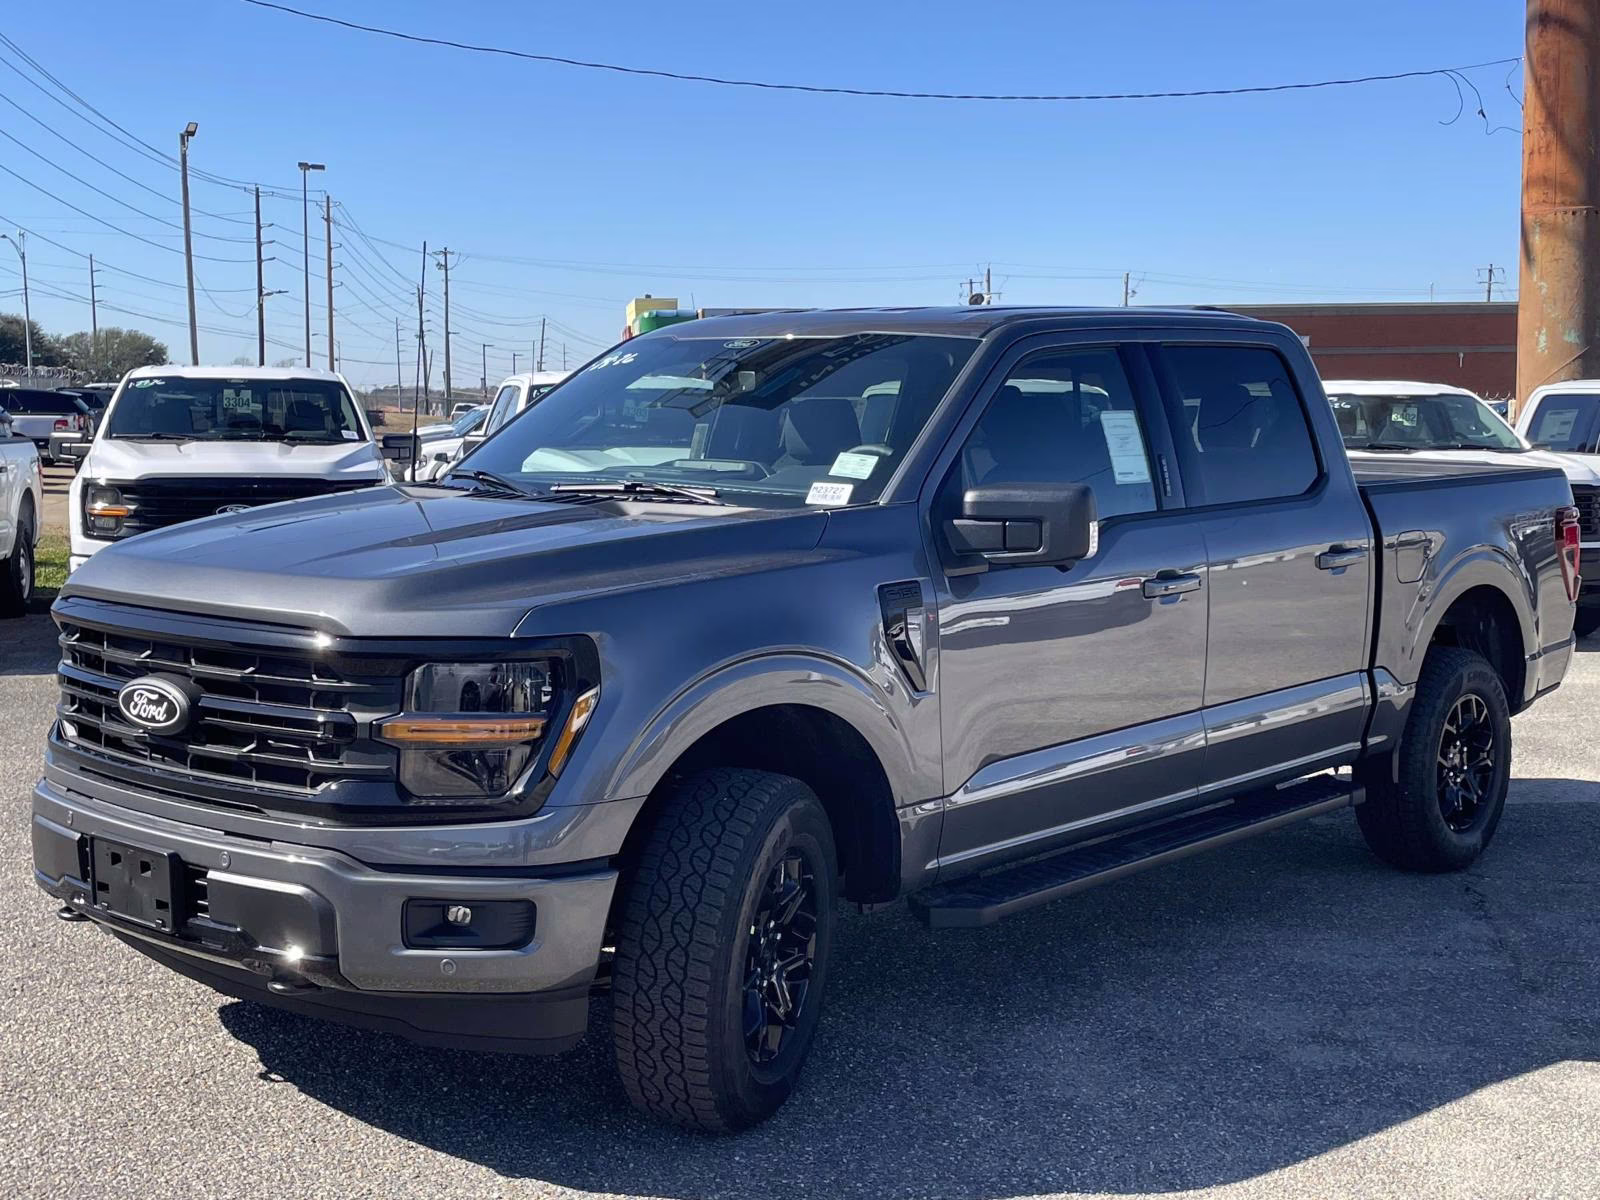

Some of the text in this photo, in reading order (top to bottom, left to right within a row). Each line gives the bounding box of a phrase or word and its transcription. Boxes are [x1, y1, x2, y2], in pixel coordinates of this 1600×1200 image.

[224, 397, 251, 408] 3304
[811, 486, 845, 495] M23727
[130, 690, 168, 721] Ford
